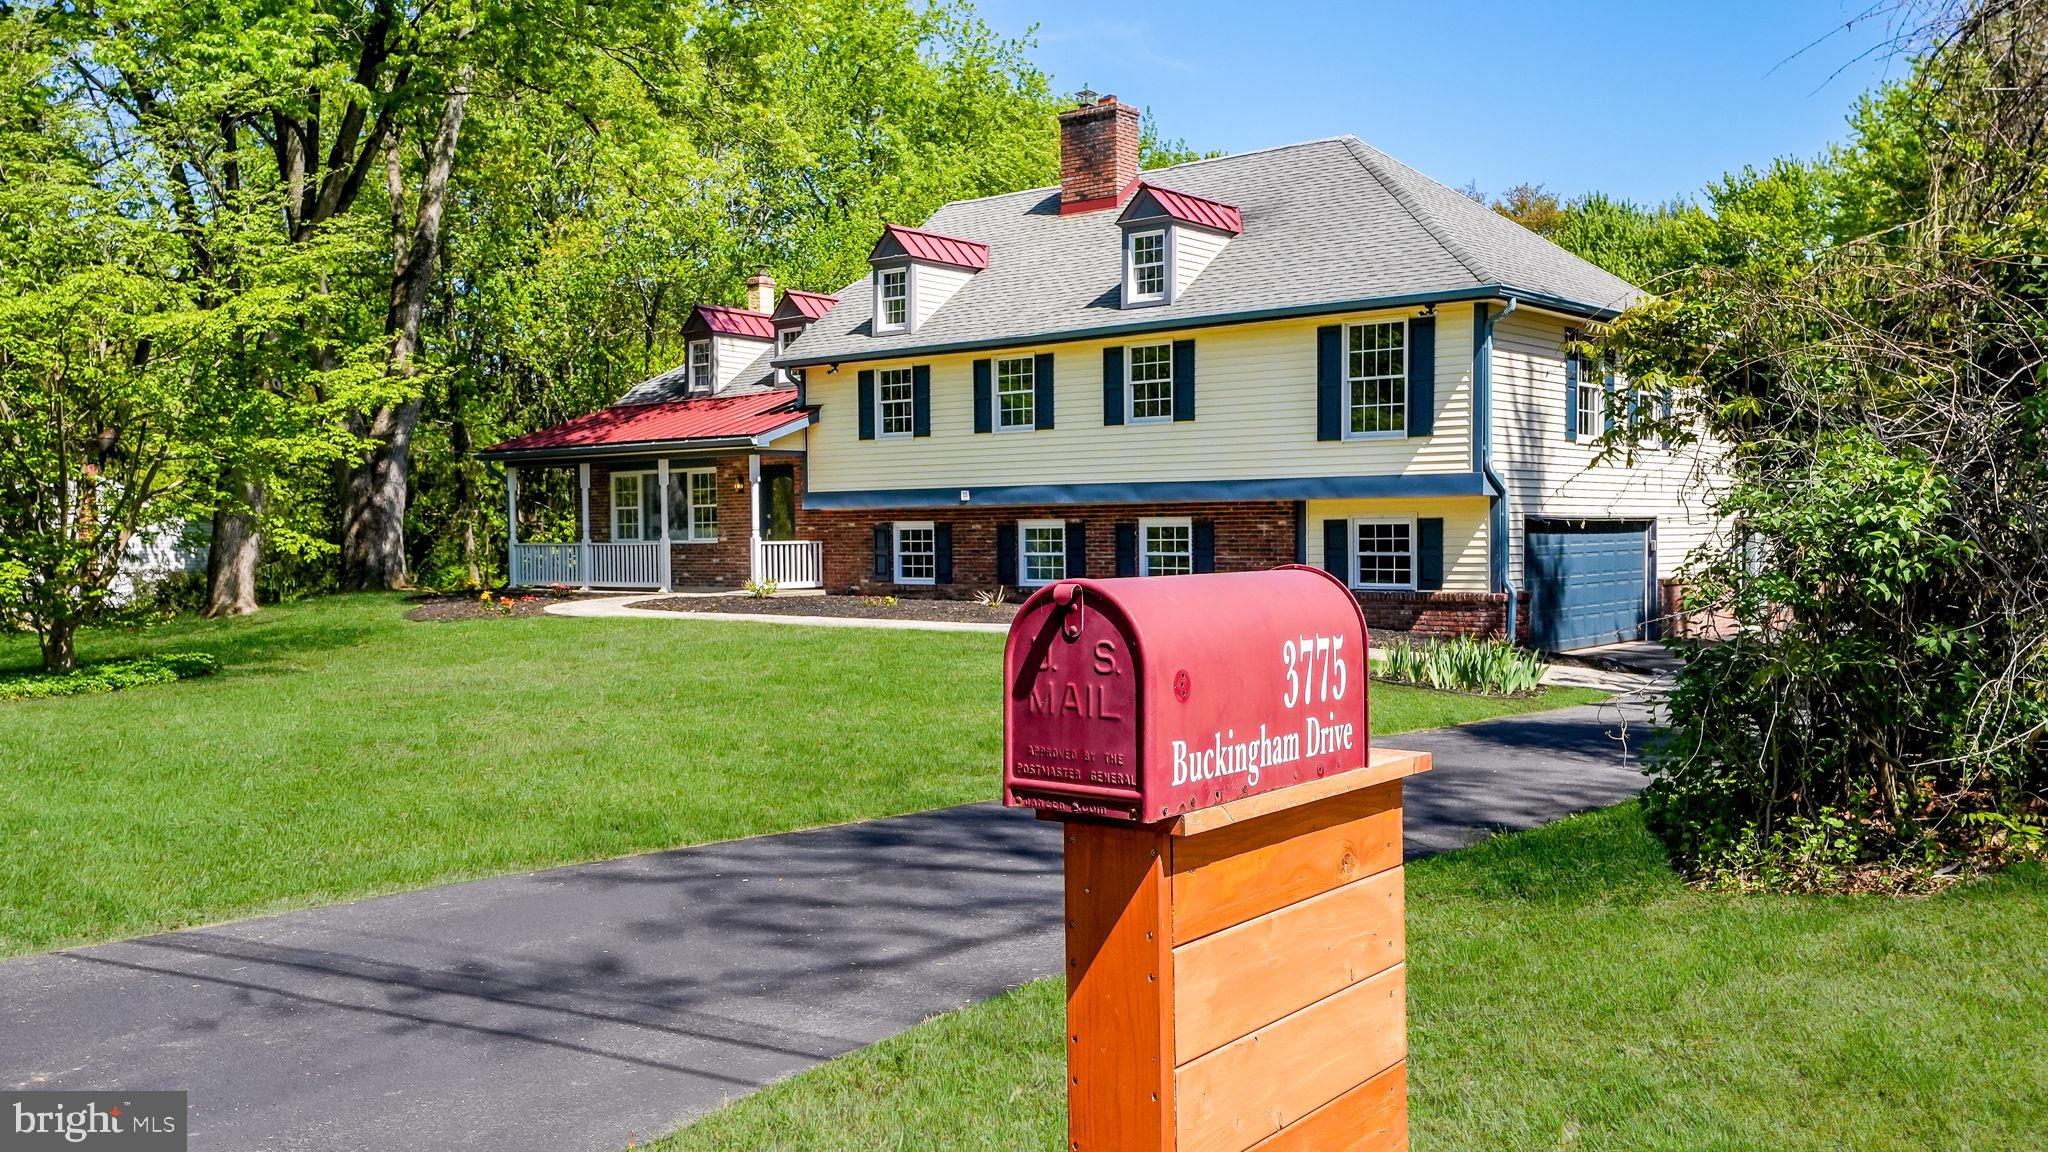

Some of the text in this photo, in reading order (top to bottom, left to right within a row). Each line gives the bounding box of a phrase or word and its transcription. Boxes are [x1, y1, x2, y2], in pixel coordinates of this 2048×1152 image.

[1094, 639, 1122, 676] S.
[1283, 633, 1347, 709] 3775
[1028, 681, 1121, 721] MAIL
[1029, 744, 1125, 766] APPROVED BY THE
[1171, 711, 1353, 787] Buckingham Drive
[1017, 762, 1137, 786] POSTMASTER GENERAL
